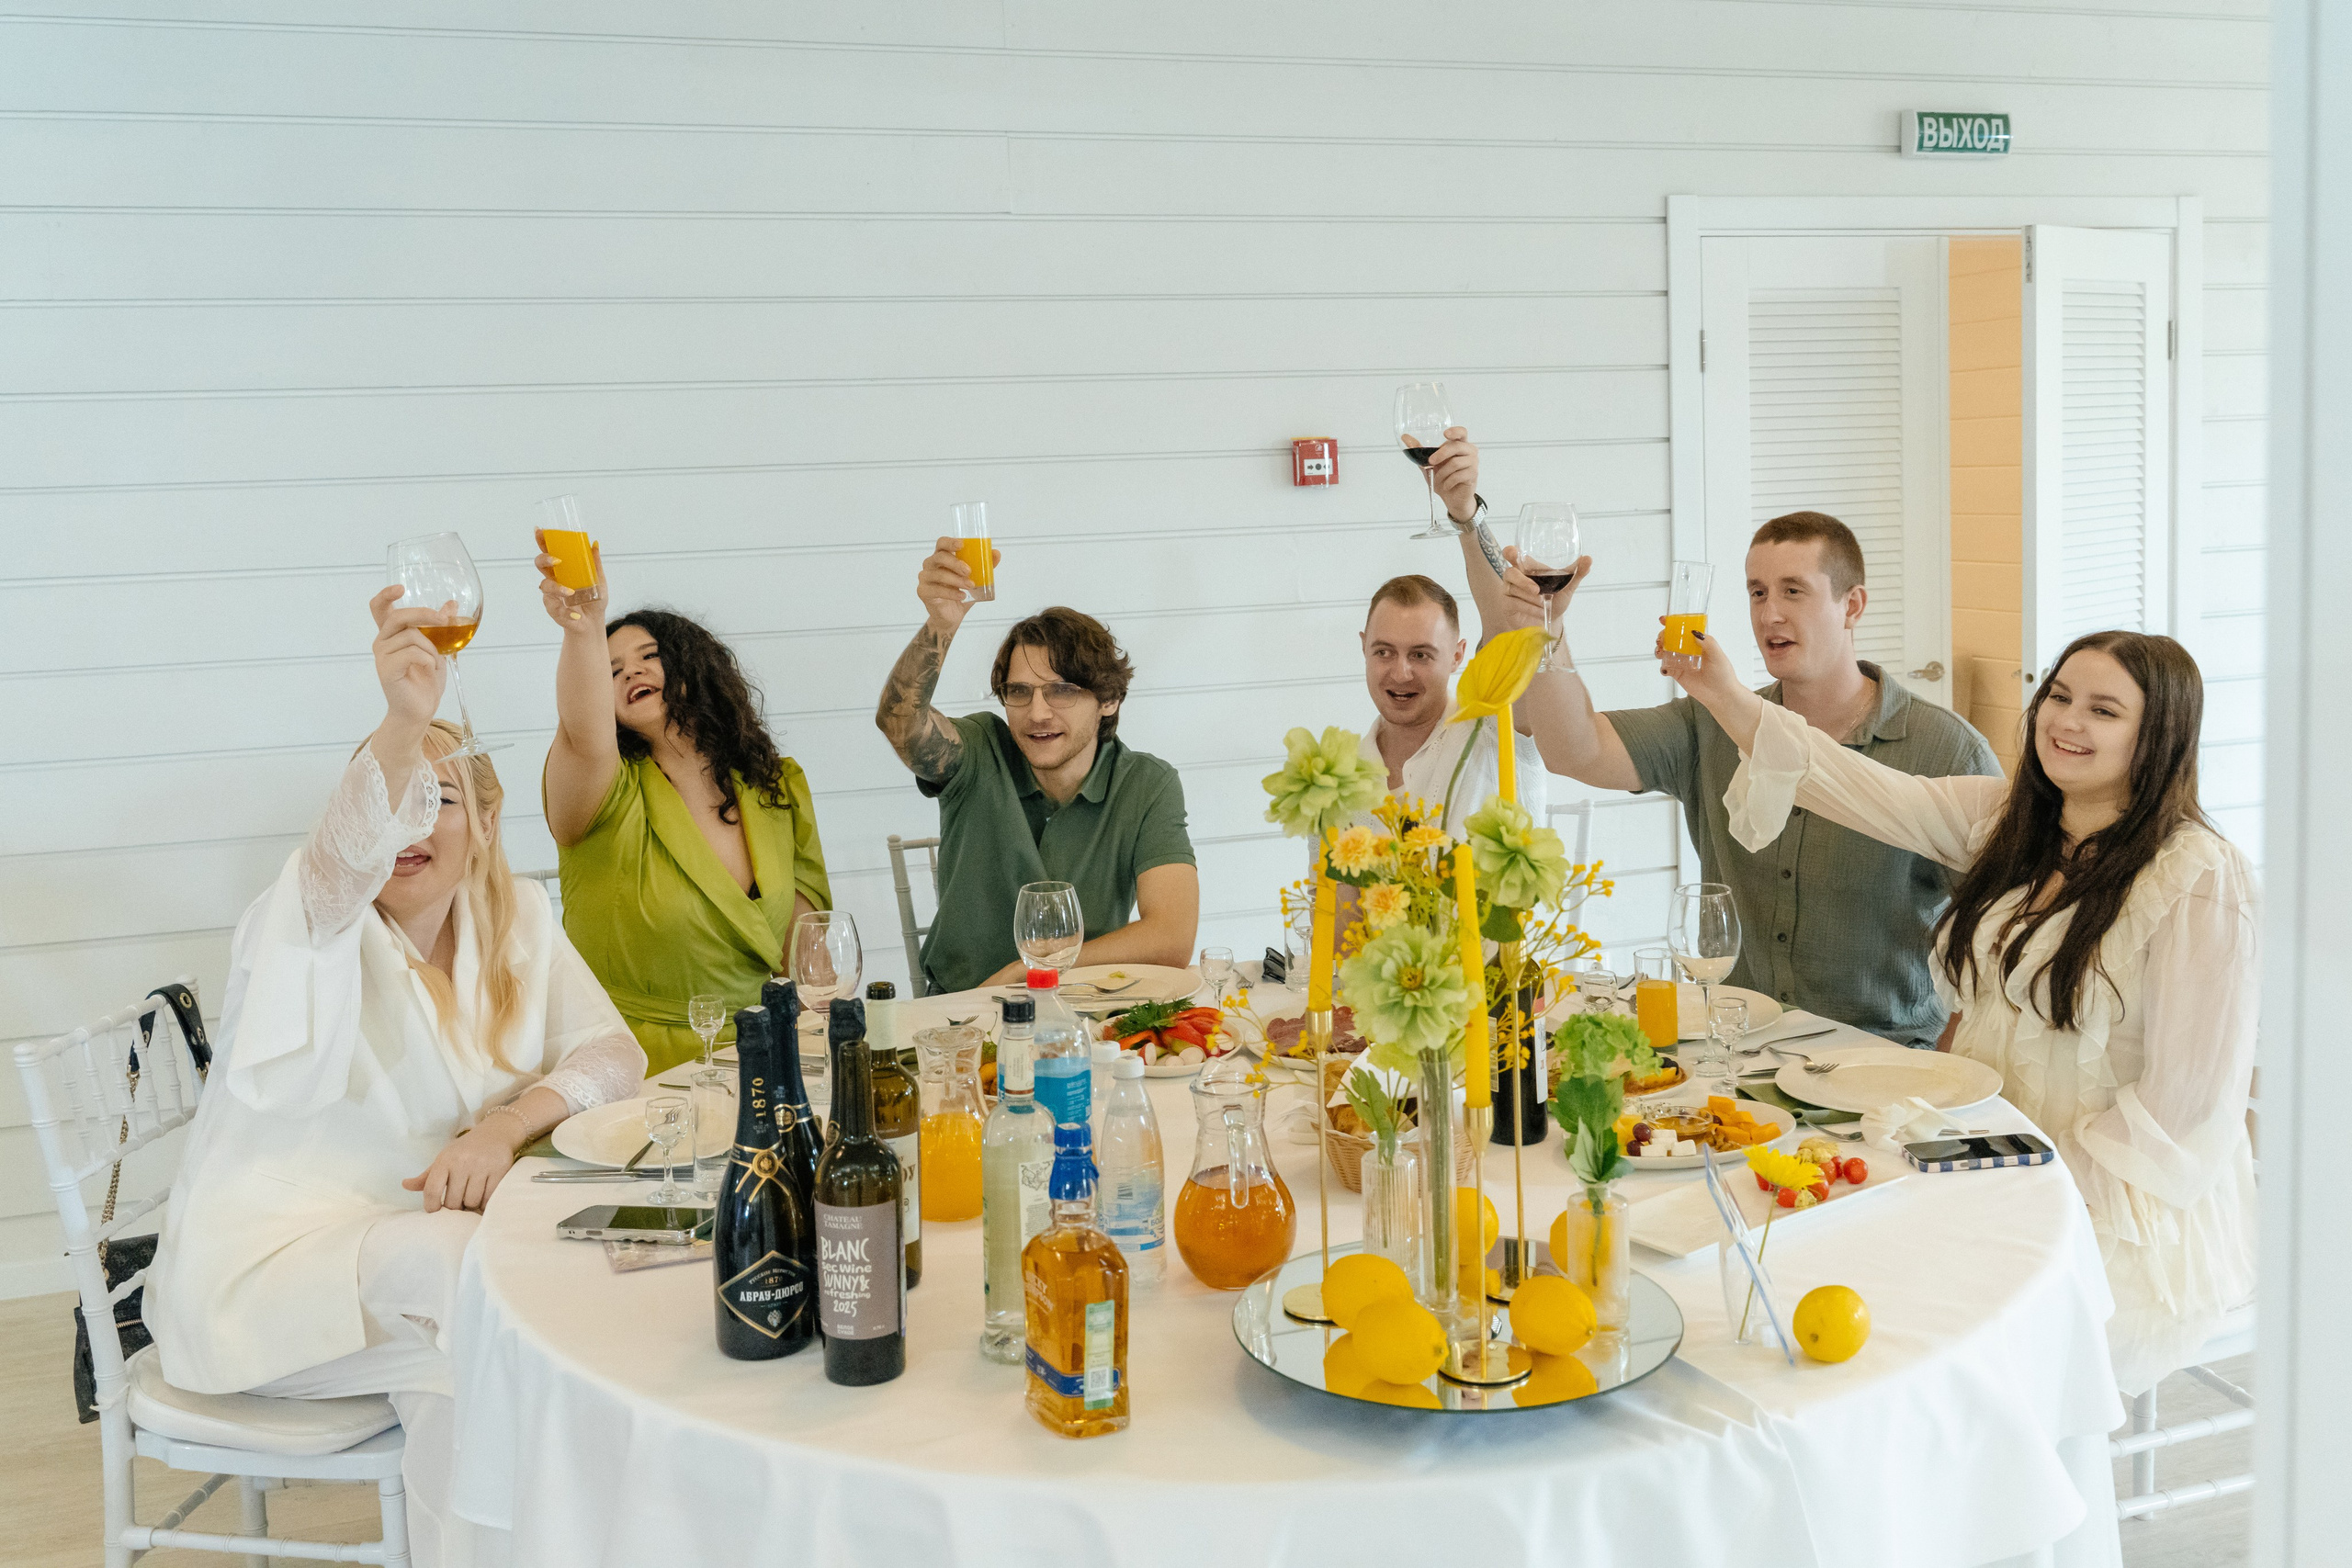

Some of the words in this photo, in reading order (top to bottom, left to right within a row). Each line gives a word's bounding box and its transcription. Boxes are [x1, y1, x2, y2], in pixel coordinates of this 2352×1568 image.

[1923, 117, 2005, 152] ВЫХОД
[751, 1077, 767, 1118] 1870
[823, 1213, 863, 1223] CHATEAU
[820, 1235, 870, 1263] BLANC
[739, 1281, 804, 1302] АБРАУ-ДЮРСО
[833, 1300, 858, 1317] 2025
